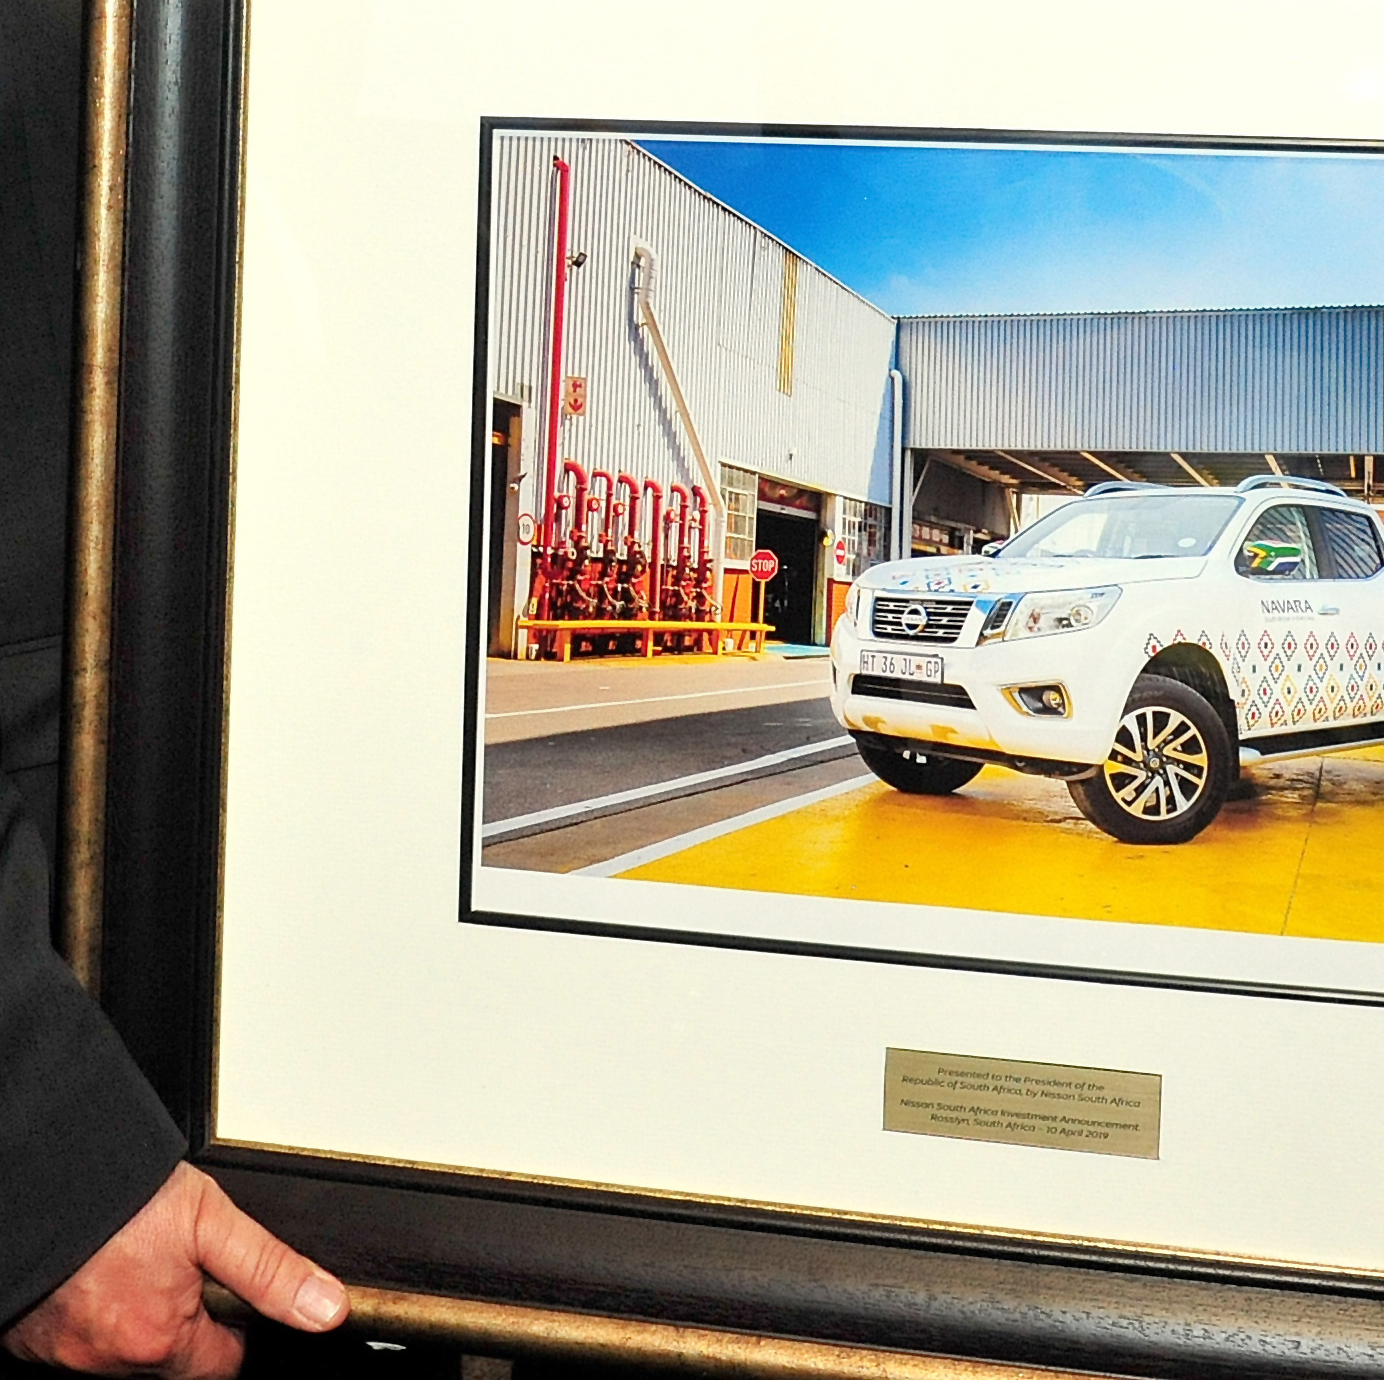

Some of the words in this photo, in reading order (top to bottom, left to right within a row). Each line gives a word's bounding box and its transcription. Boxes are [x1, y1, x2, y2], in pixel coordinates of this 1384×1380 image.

[751, 558, 775, 572] STOP
[1260, 599, 1314, 614] NAVARA
[881, 656, 896, 674] 36
[925, 660, 940, 678] GP
[937, 1067, 989, 1080] Presented
[991, 1073, 1002, 1081] to
[1004, 1074, 1021, 1083] the
[1023, 1076, 1072, 1089] President
[1074, 1082, 1086, 1091] of
[1087, 1083, 1105, 1092] the
[901, 1075, 945, 1088] Republic
[947, 1080, 958, 1090] of
[960, 1081, 990, 1092] South
[1025, 1088, 1038, 1098] by
[1040, 1089, 1075, 1101] Nissan
[1077, 1093, 1108, 1104] South
[1109, 1097, 1141, 1108] Africa
[900, 1098, 935, 1109] Nissan
[936, 1102, 967, 1113] South
[968, 1106, 999, 1116] Africa
[1000, 1108, 1058, 1122] Investment
[973, 1118, 1004, 1128] South
[1005, 1122, 1036, 1132] Africa
[1046, 1126, 1058, 1135] 10
[1059, 1127, 1084, 1137] April
[1085, 1129, 1110, 1140] 2019
